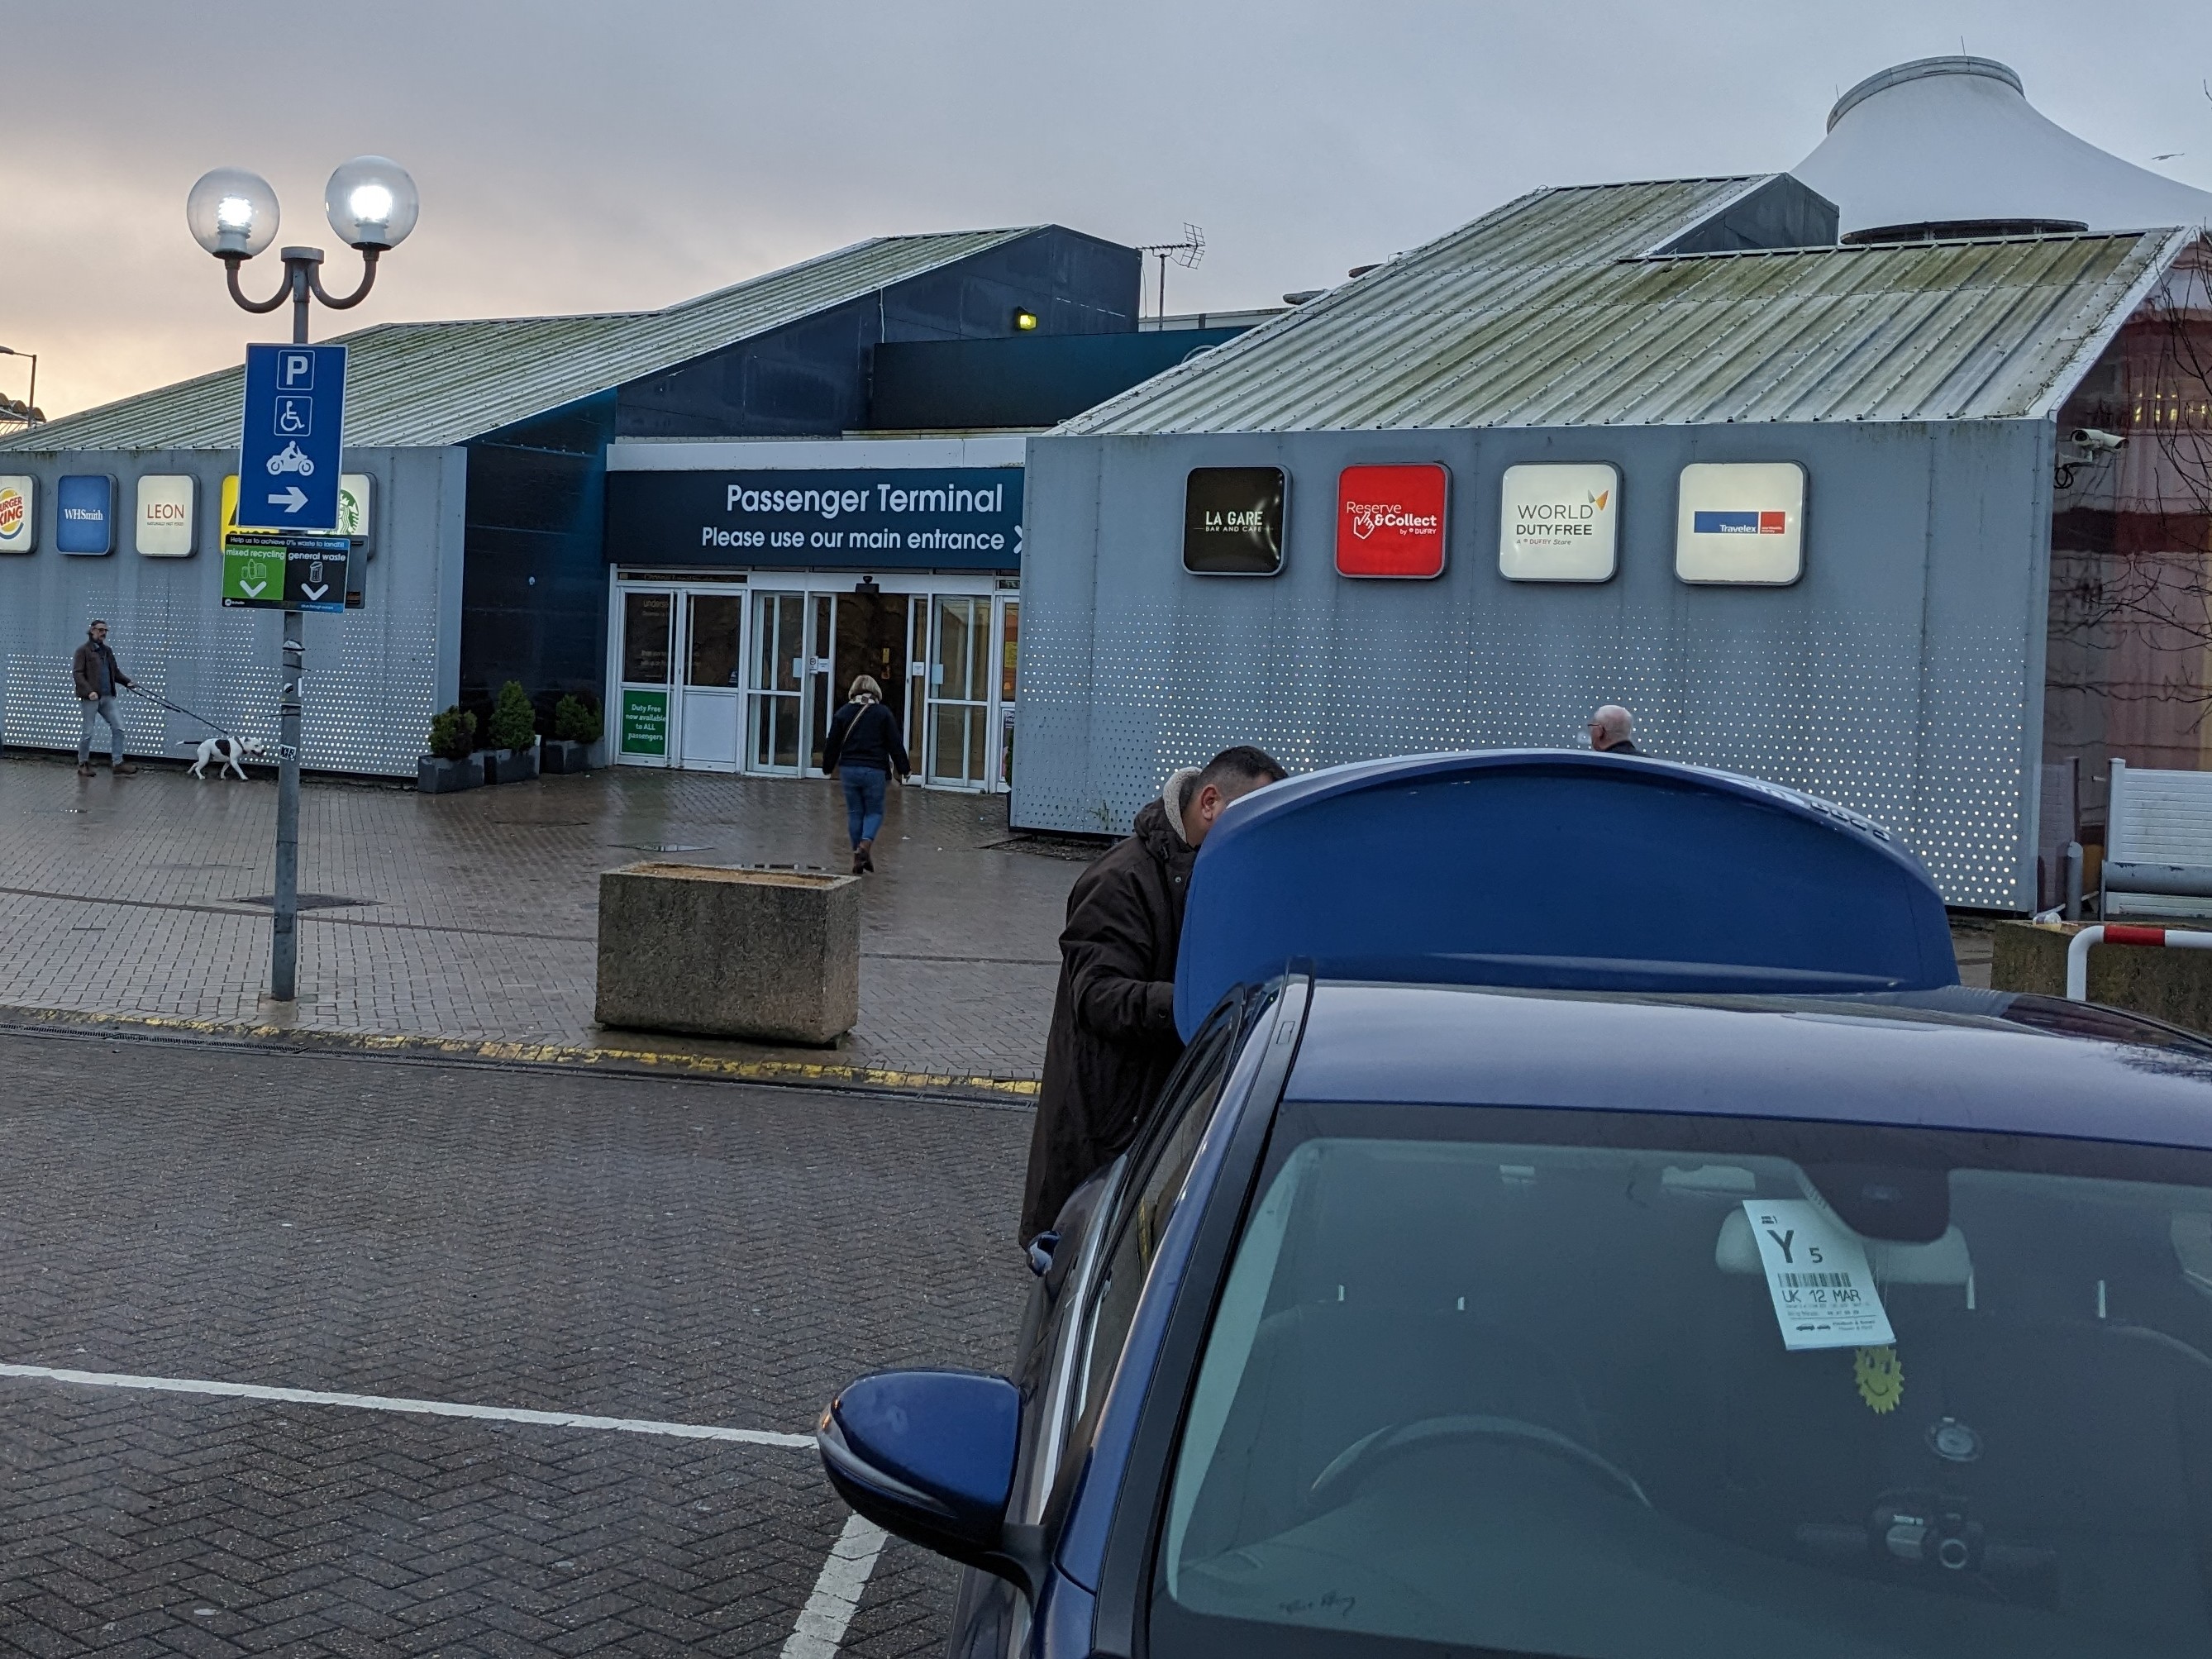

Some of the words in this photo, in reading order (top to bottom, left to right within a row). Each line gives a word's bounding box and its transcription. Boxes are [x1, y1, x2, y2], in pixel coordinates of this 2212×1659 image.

[287, 356, 307, 385] P
[0, 496, 22, 512] URGER
[727, 484, 870, 519] Passenger
[877, 484, 1003, 512] Terminal
[1347, 501, 1402, 513] Reserve
[64, 509, 103, 520] WHSmith
[147, 504, 184, 519] LEON
[1206, 511, 1223, 526] LA
[1228, 511, 1263, 526] GARE
[1517, 505, 1594, 519] WORLD
[1374, 513, 1437, 527] &Collect
[1719, 524, 1757, 532] Travelex
[702, 527, 765, 547] Please
[770, 532, 805, 547] use
[810, 532, 844, 548] our
[849, 528, 901, 549] main
[907, 528, 1005, 550] entrance
[226, 547, 249, 556] mixed
[250, 550, 285, 560] recycling
[288, 552, 321, 561] general
[322, 553, 346, 561] waste
[632, 703, 647, 713] Duty
[639, 713, 667, 722] available
[628, 733, 663, 741] passengers
[1766, 1229, 1795, 1264] Y
[1809, 1247, 1823, 1264] 5
[1781, 1290, 1802, 1303] UK
[1809, 1290, 1827, 1303] 12
[1833, 1290, 1861, 1303] MAR
